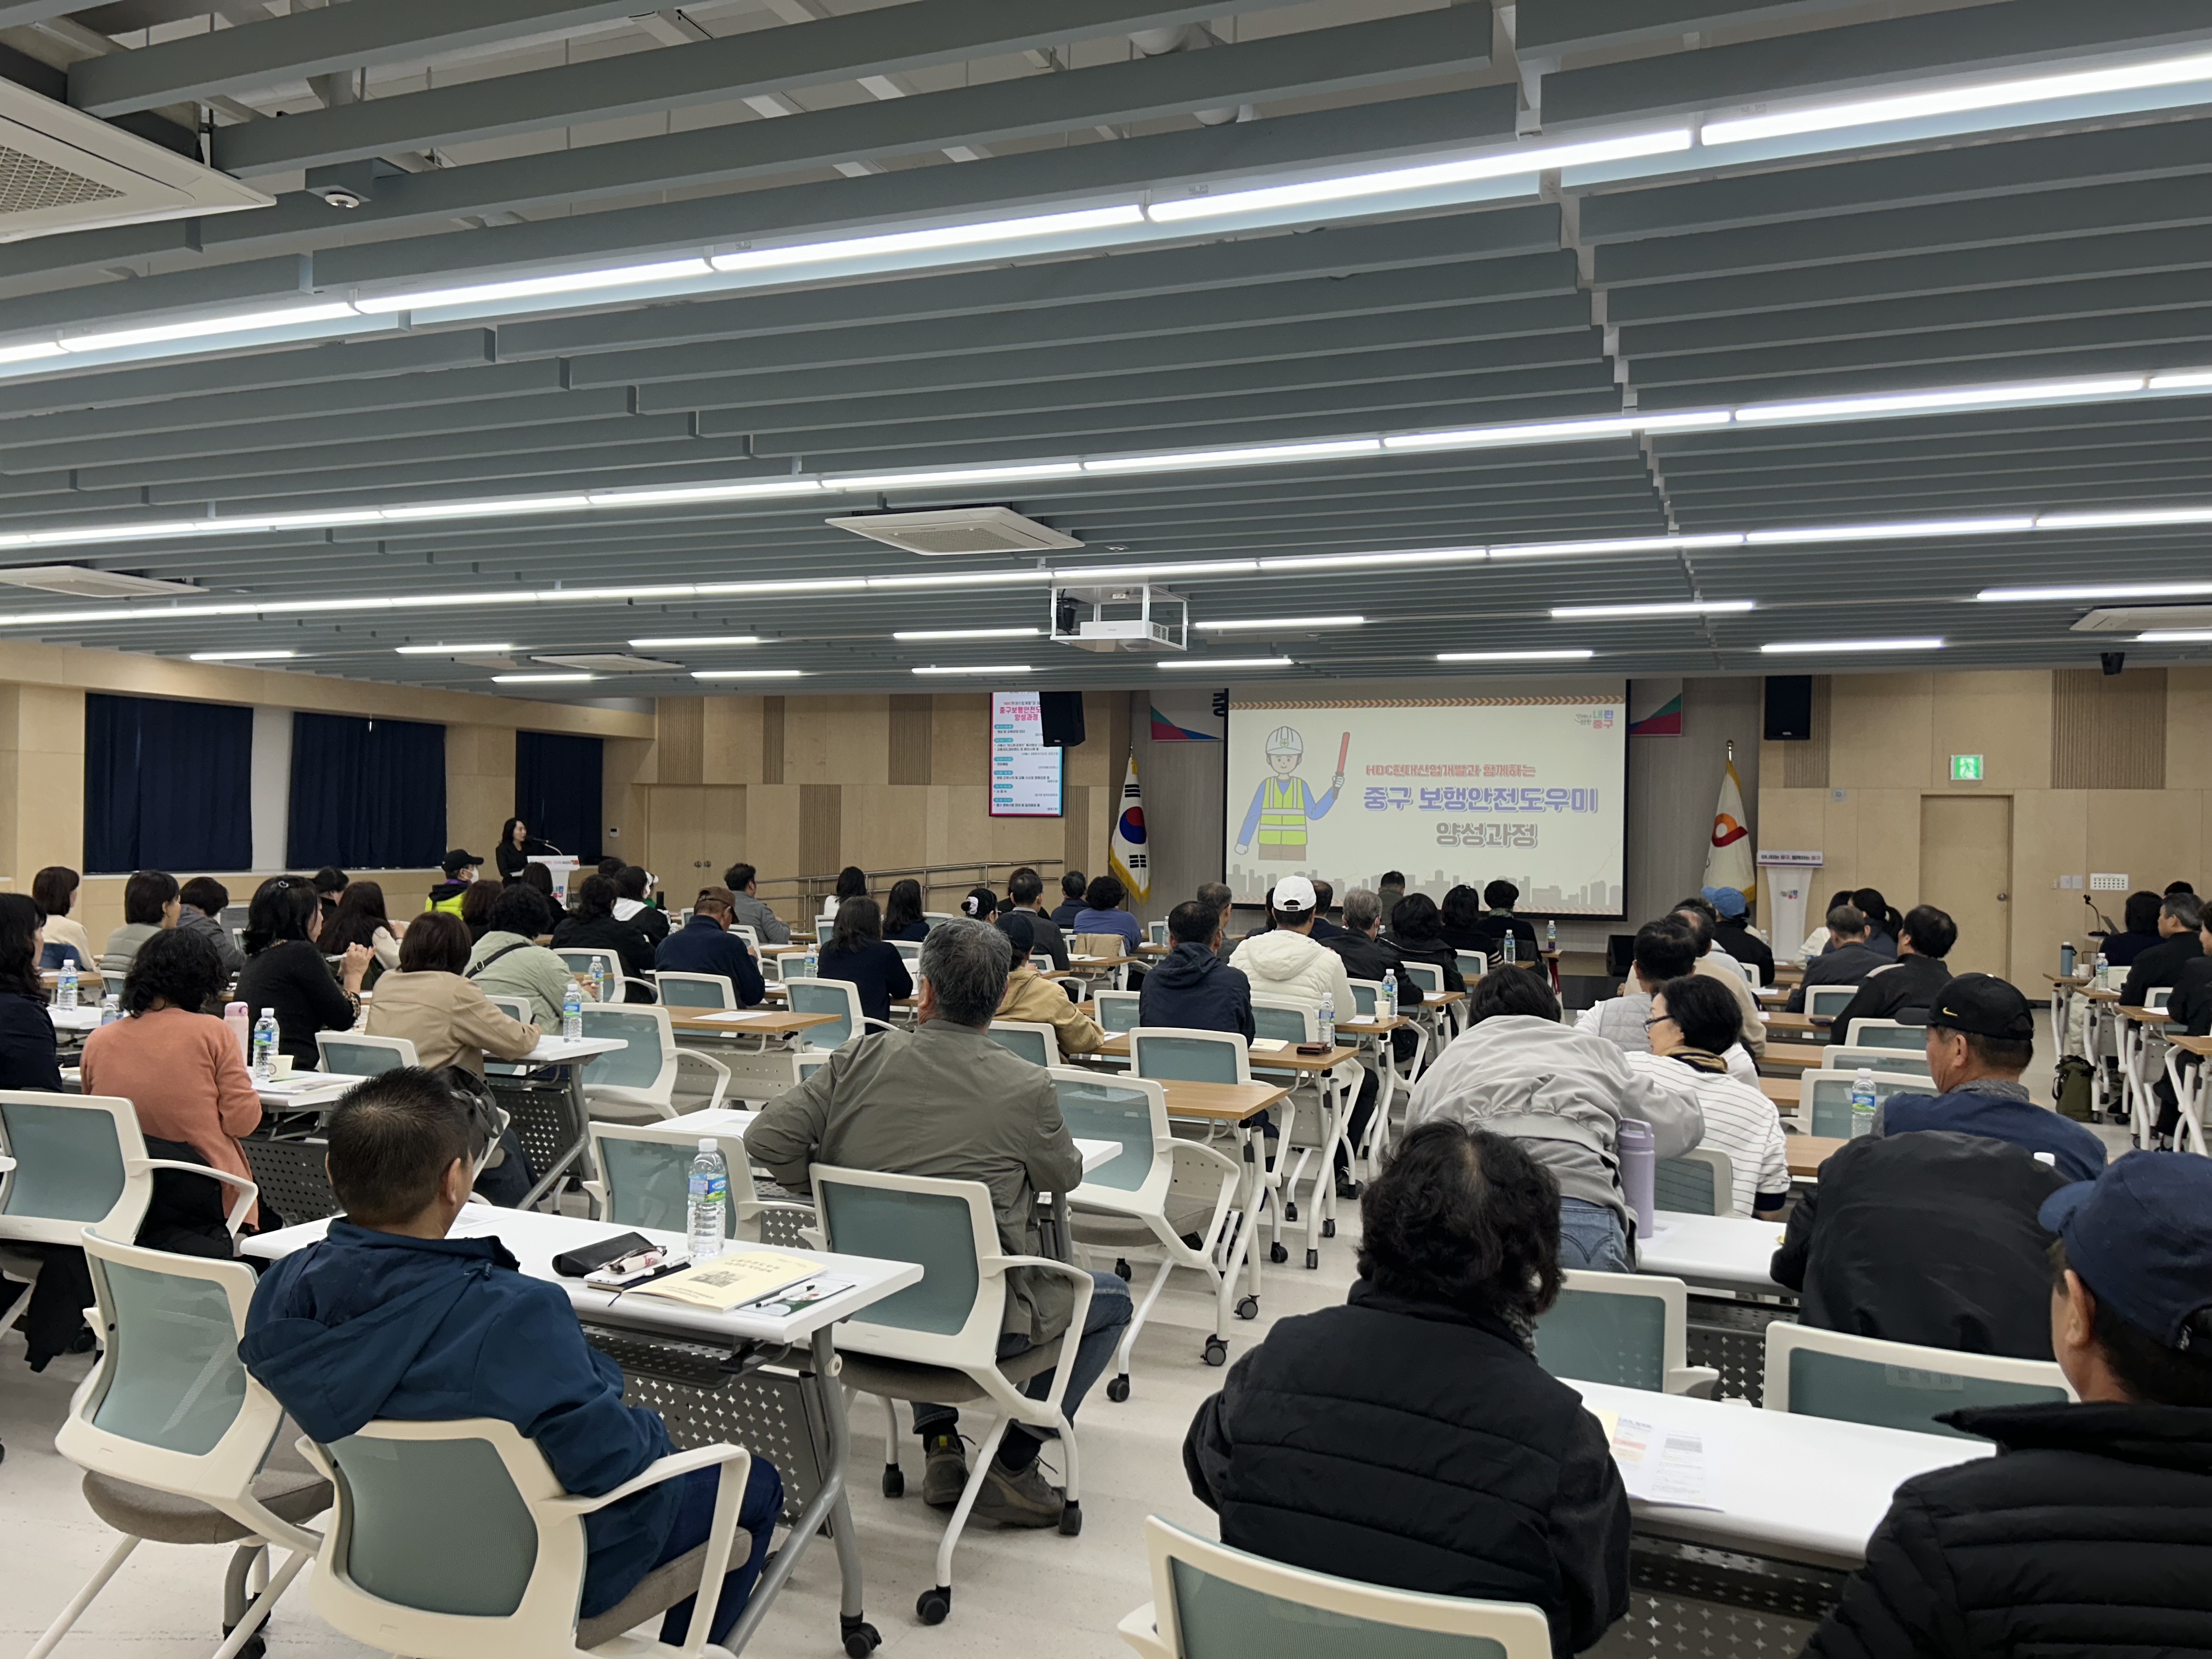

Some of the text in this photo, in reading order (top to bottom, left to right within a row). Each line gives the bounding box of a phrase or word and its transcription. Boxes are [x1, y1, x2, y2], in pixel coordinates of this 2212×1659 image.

[1365, 764, 1536, 777] HDC현대산업개발과 함께하는
[1363, 786, 1599, 813] 중구 보행안전도우미
[1435, 822, 1538, 848] 양성과정
